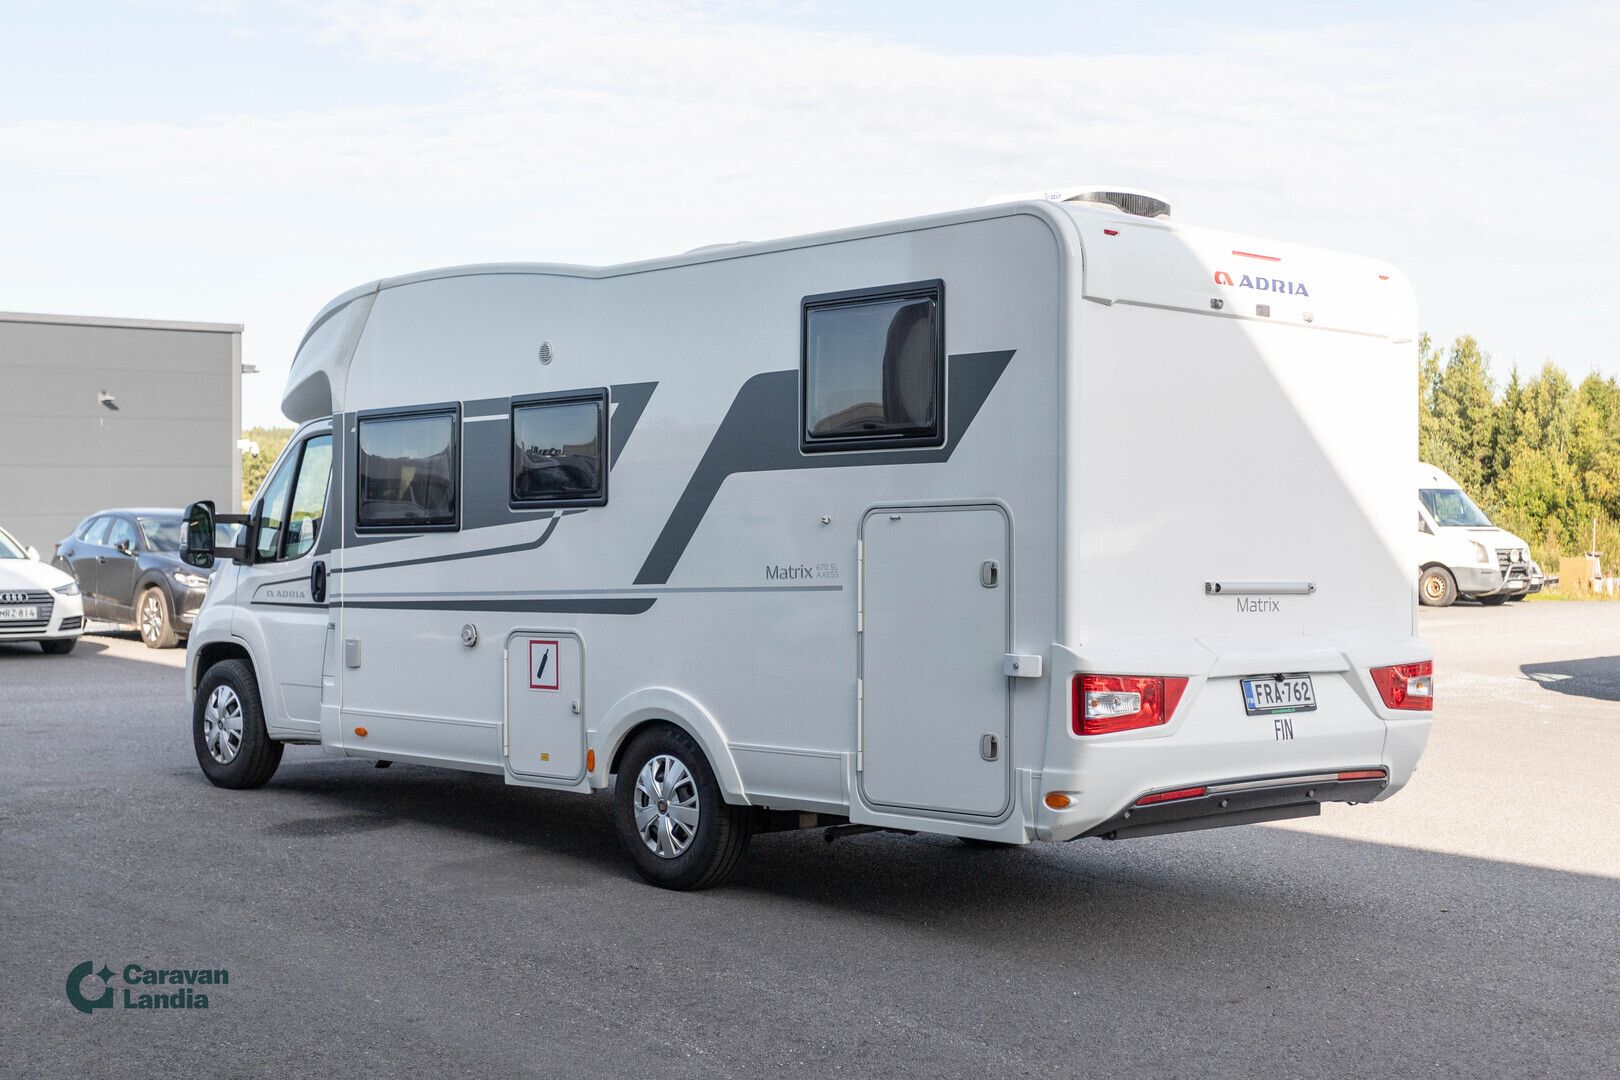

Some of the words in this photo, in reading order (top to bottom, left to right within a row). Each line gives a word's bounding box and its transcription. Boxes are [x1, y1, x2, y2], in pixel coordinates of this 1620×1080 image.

[1239, 274, 1309, 297] ADRIA
[765, 564, 813, 581] Matrix
[815, 563, 829, 572] 670
[815, 571, 840, 580] AXESS
[277, 590, 306, 599] ADRIA
[1236, 597, 1280, 613] Matrix
[1274, 718, 1294, 741] FIN
